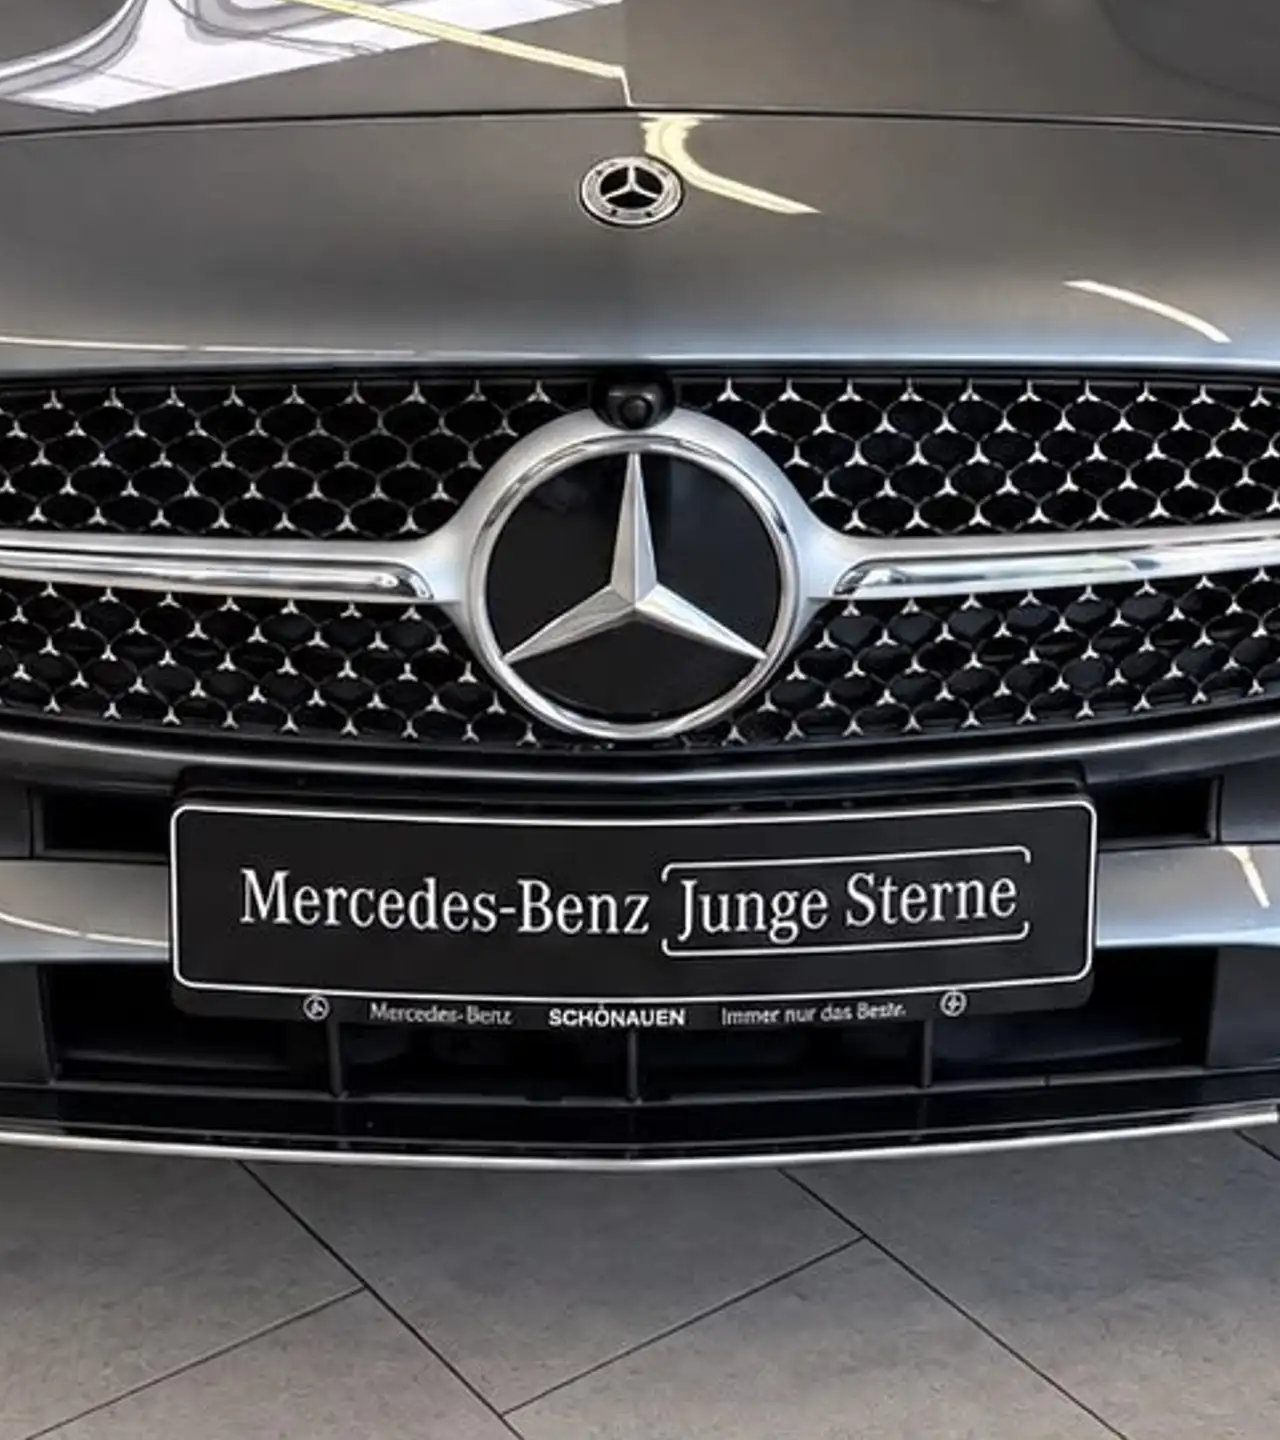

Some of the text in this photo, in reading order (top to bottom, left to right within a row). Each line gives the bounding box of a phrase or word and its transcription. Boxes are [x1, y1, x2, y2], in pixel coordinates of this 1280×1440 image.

[239, 867, 1019, 944] Mercedes-Benz Junge Sterne
[369, 1002, 514, 1026] Mercedes-Benz
[548, 1002, 685, 1028] SCHÖNAUEN
[722, 1007, 781, 1026] Immer
[785, 1007, 816, 1023] nur
[820, 1003, 853, 1022] das
